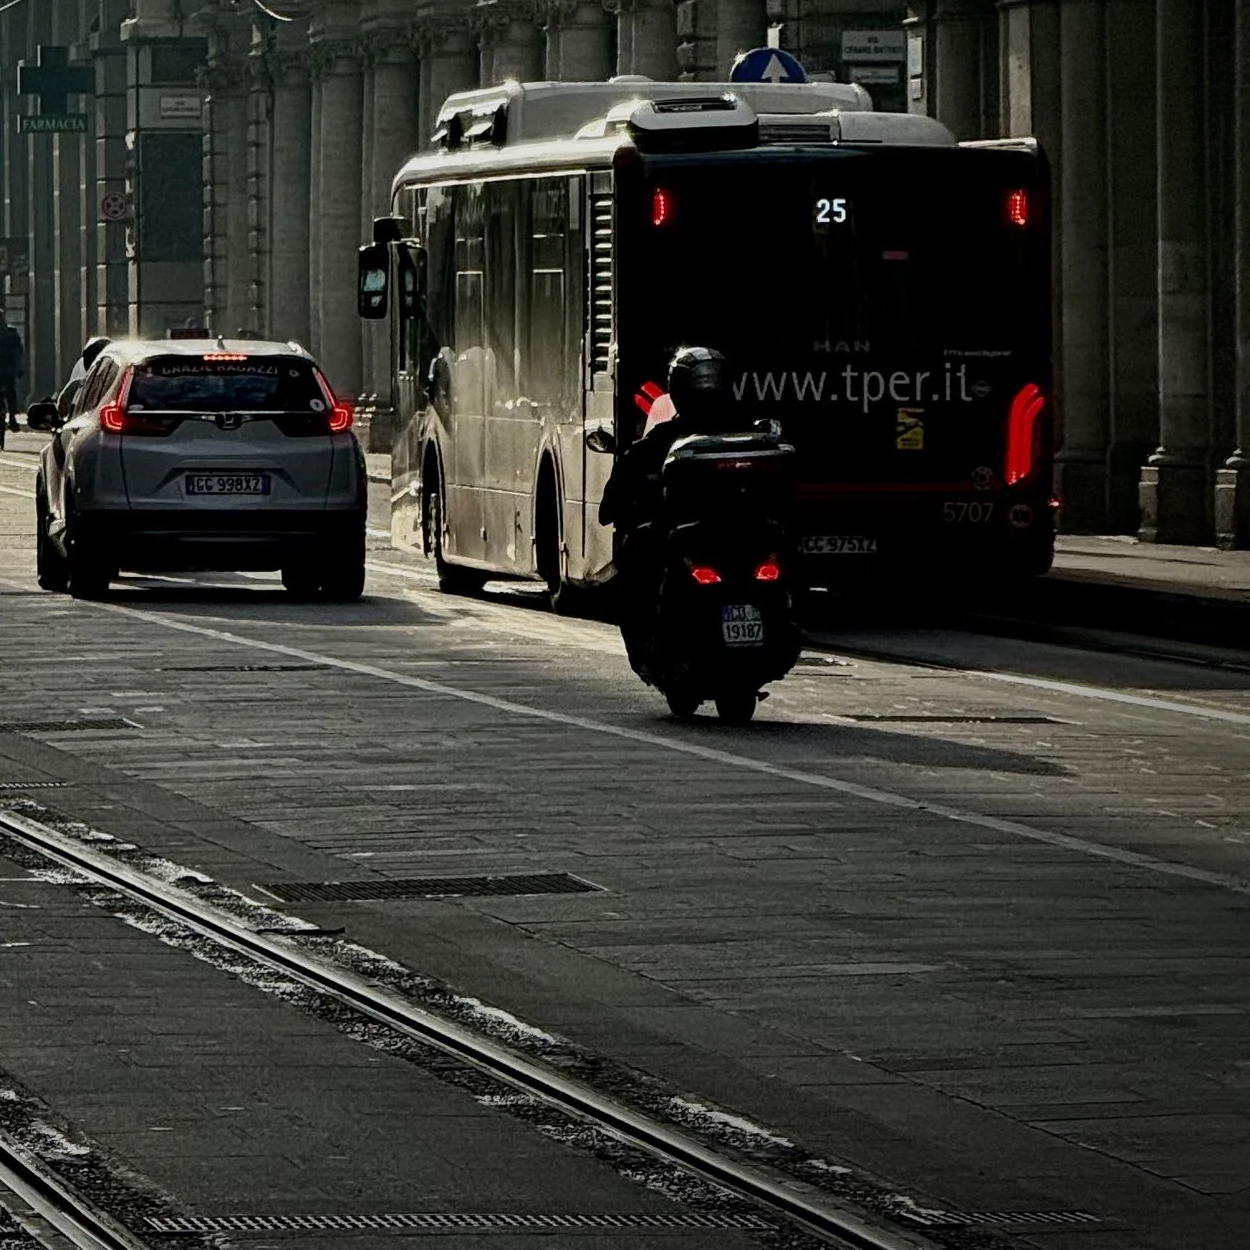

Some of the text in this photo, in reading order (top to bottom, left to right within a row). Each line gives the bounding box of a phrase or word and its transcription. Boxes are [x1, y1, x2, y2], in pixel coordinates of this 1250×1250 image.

[22, 119, 85, 130] FARMACIA
[815, 197, 848, 224] 25
[812, 340, 871, 353] MAN
[941, 502, 996, 524] 5707
[726, 623, 762, 639] 19187
